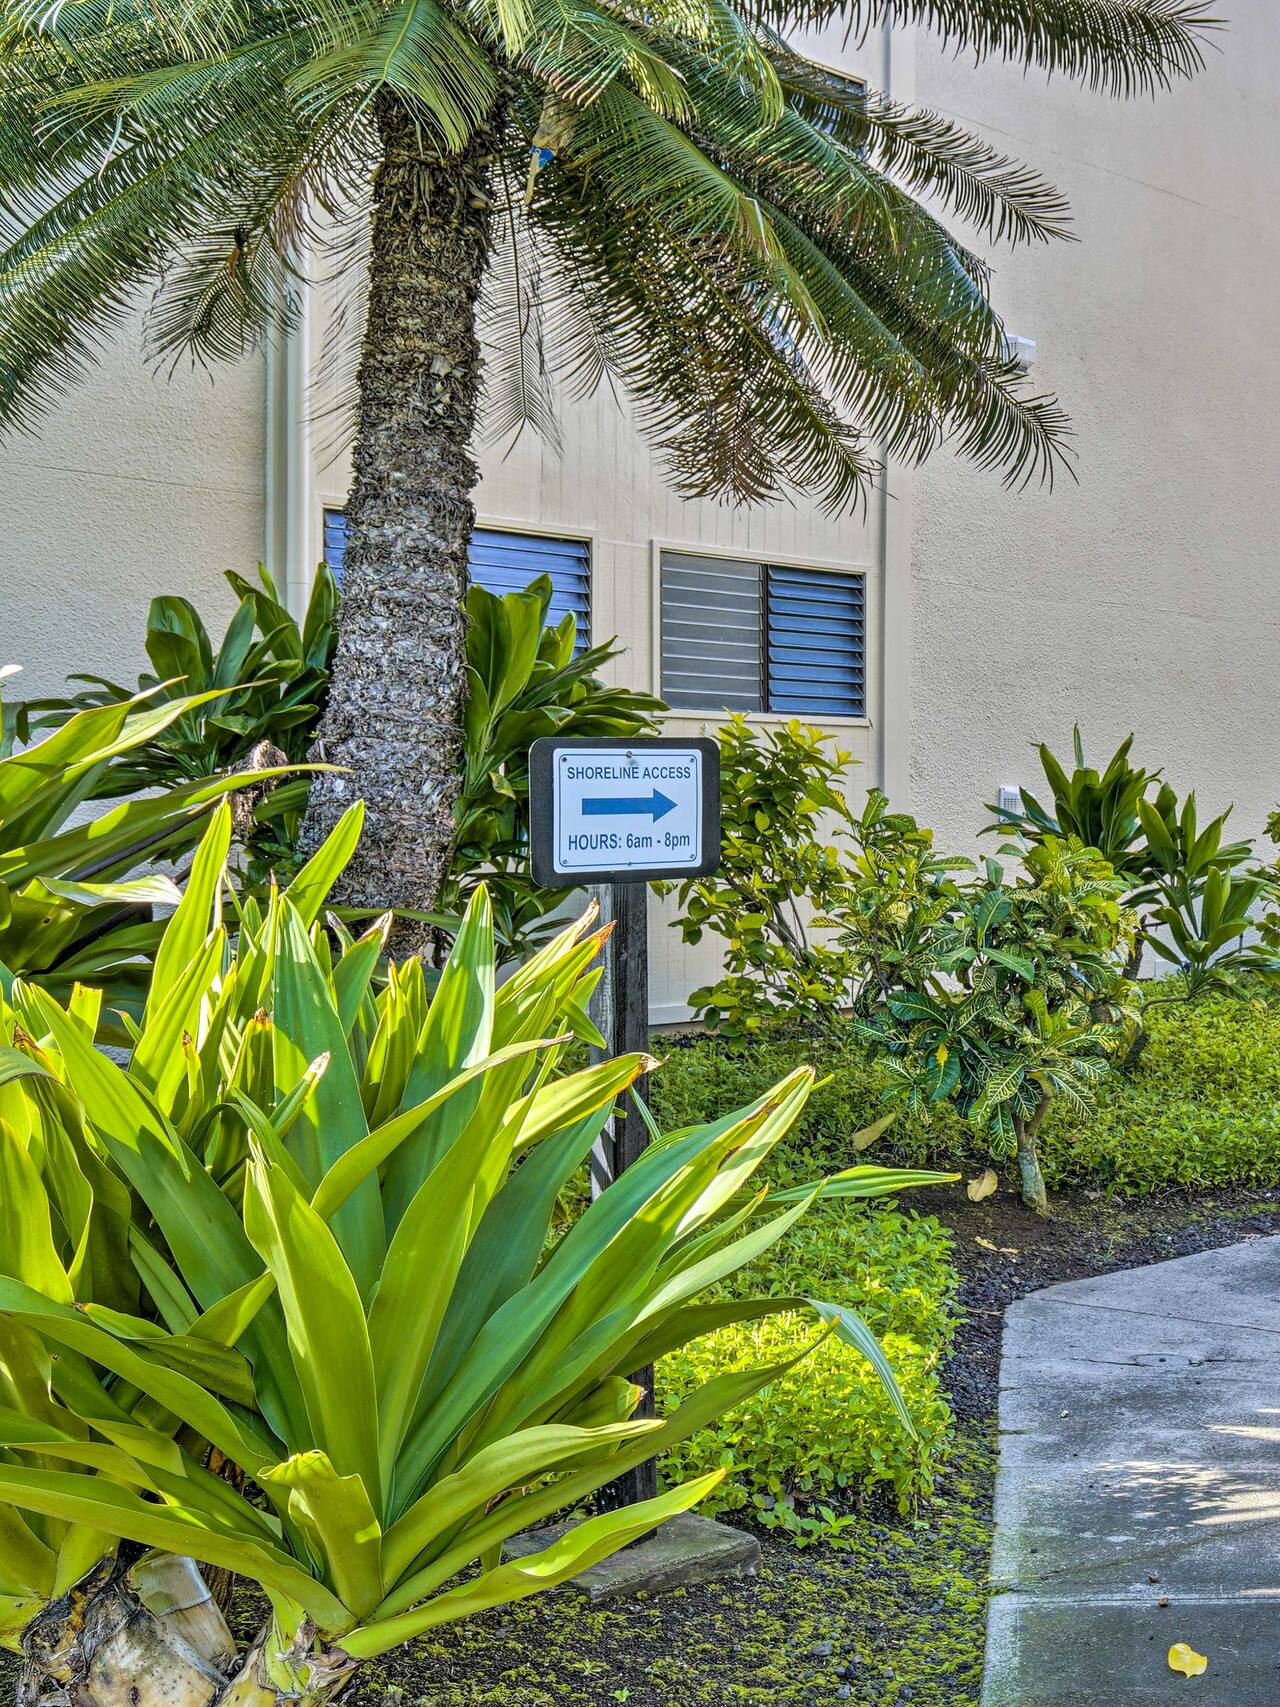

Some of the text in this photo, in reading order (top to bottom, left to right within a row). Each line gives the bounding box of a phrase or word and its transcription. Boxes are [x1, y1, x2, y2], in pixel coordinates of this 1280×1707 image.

[567, 766, 691, 780] SHORELINE ACCESS
[568, 834, 622, 850] HOURS:
[626, 833, 652, 849] 6am
[664, 832, 690, 850] 8pm
